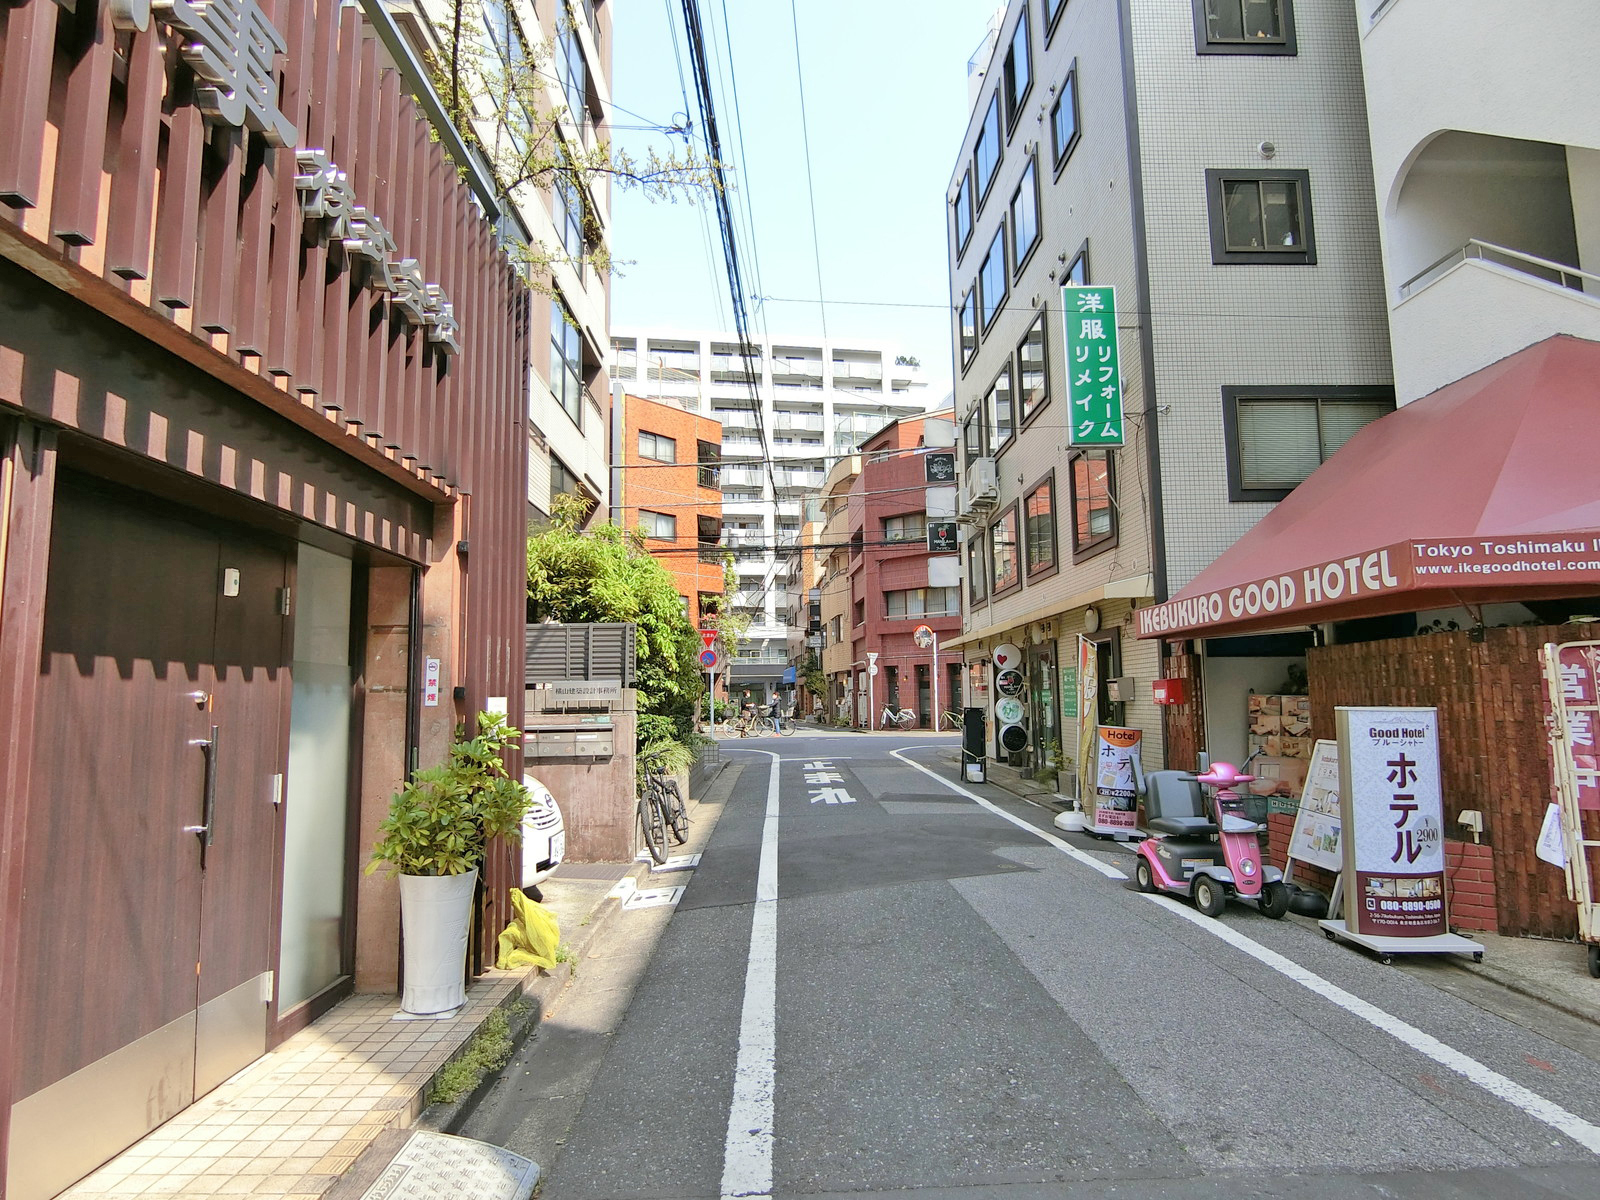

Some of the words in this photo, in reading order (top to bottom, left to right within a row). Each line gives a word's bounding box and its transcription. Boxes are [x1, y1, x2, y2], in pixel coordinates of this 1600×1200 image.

[1077, 293, 1106, 340] 洋服
[1074, 345, 1095, 437] リメイク
[1098, 345, 1119, 437] リフォーム
[1414, 544, 1473, 558] Tokyo
[1480, 539, 1585, 555] Toshimaku
[1415, 560, 1600, 574] www.ikegoodhotel.com
[1139, 592, 1223, 634] IKEBUKURO
[1228, 576, 1295, 618] GOOD
[1303, 549, 1397, 604] HOTEL
[427, 679, 436, 701] 禁煙
[1107, 730, 1135, 741] Hotel
[1369, 727, 1399, 738] Good
[1402, 727, 1425, 738] Hotel
[802, 761, 857, 804] 止まれ
[1386, 752, 1422, 864] ホテル
[1416, 829, 1438, 842] 2900
[1380, 899, 1441, 911] 080-8890-0500
